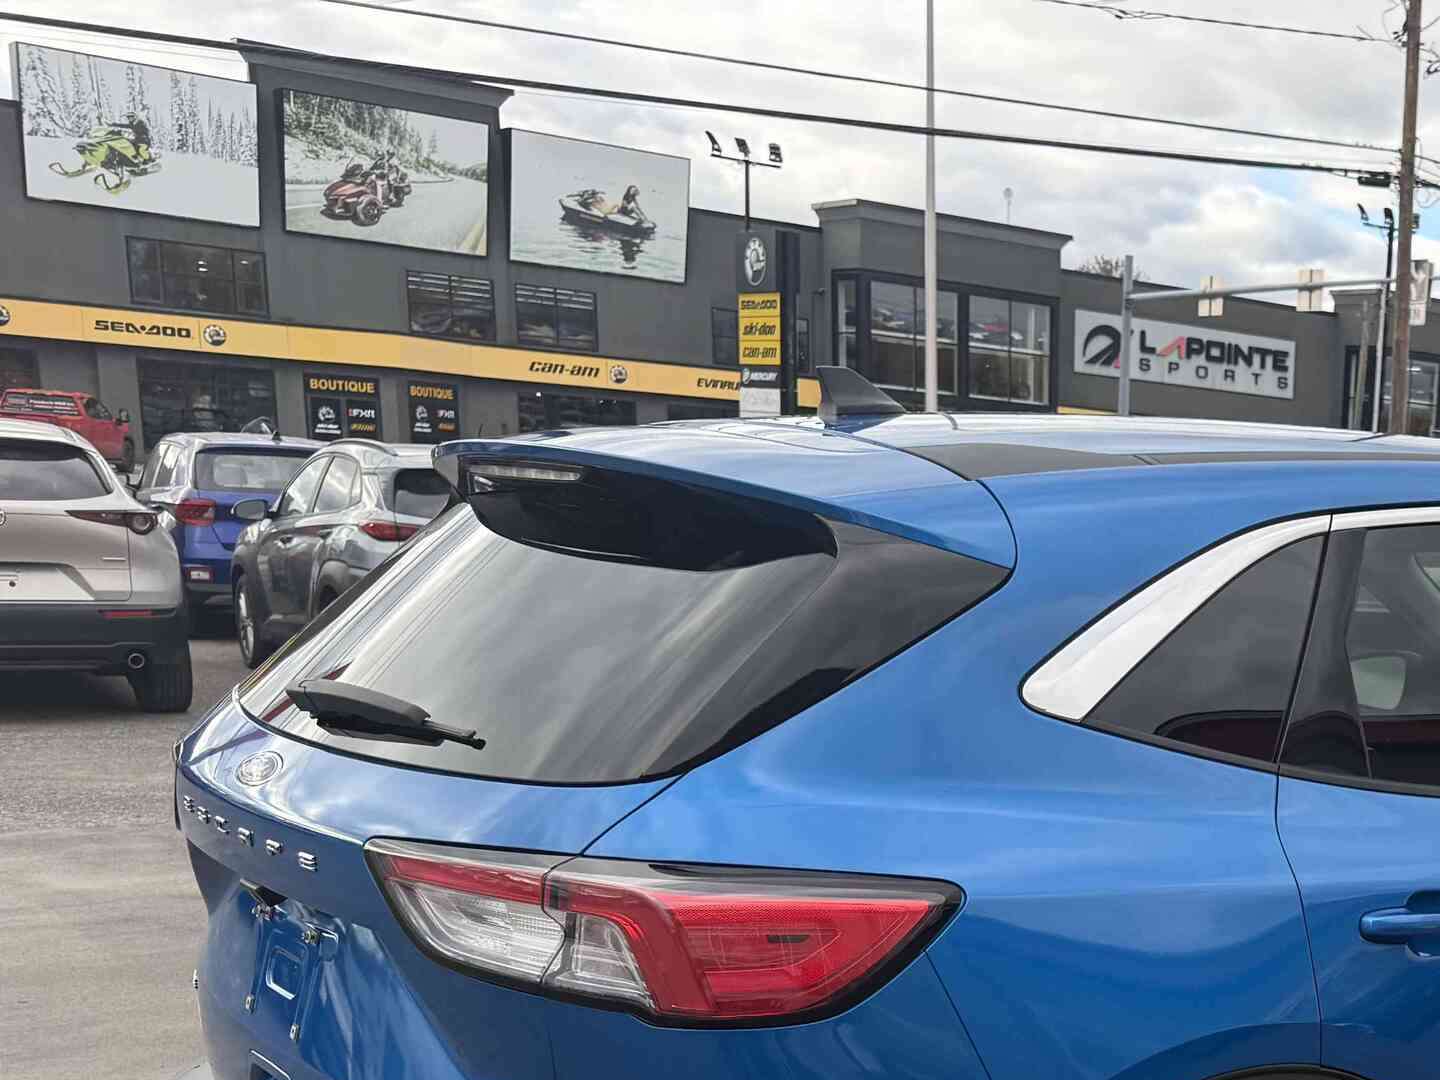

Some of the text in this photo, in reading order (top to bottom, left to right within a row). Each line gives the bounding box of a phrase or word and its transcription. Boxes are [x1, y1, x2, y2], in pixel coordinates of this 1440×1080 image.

[1139, 330, 1289, 372] LAPOINTE
[528, 359, 600, 379] can-am
[1138, 358, 1289, 389] SPORTS
[309, 378, 375, 394] BOUTIQUE
[409, 385, 454, 400] BOUTIQUE
